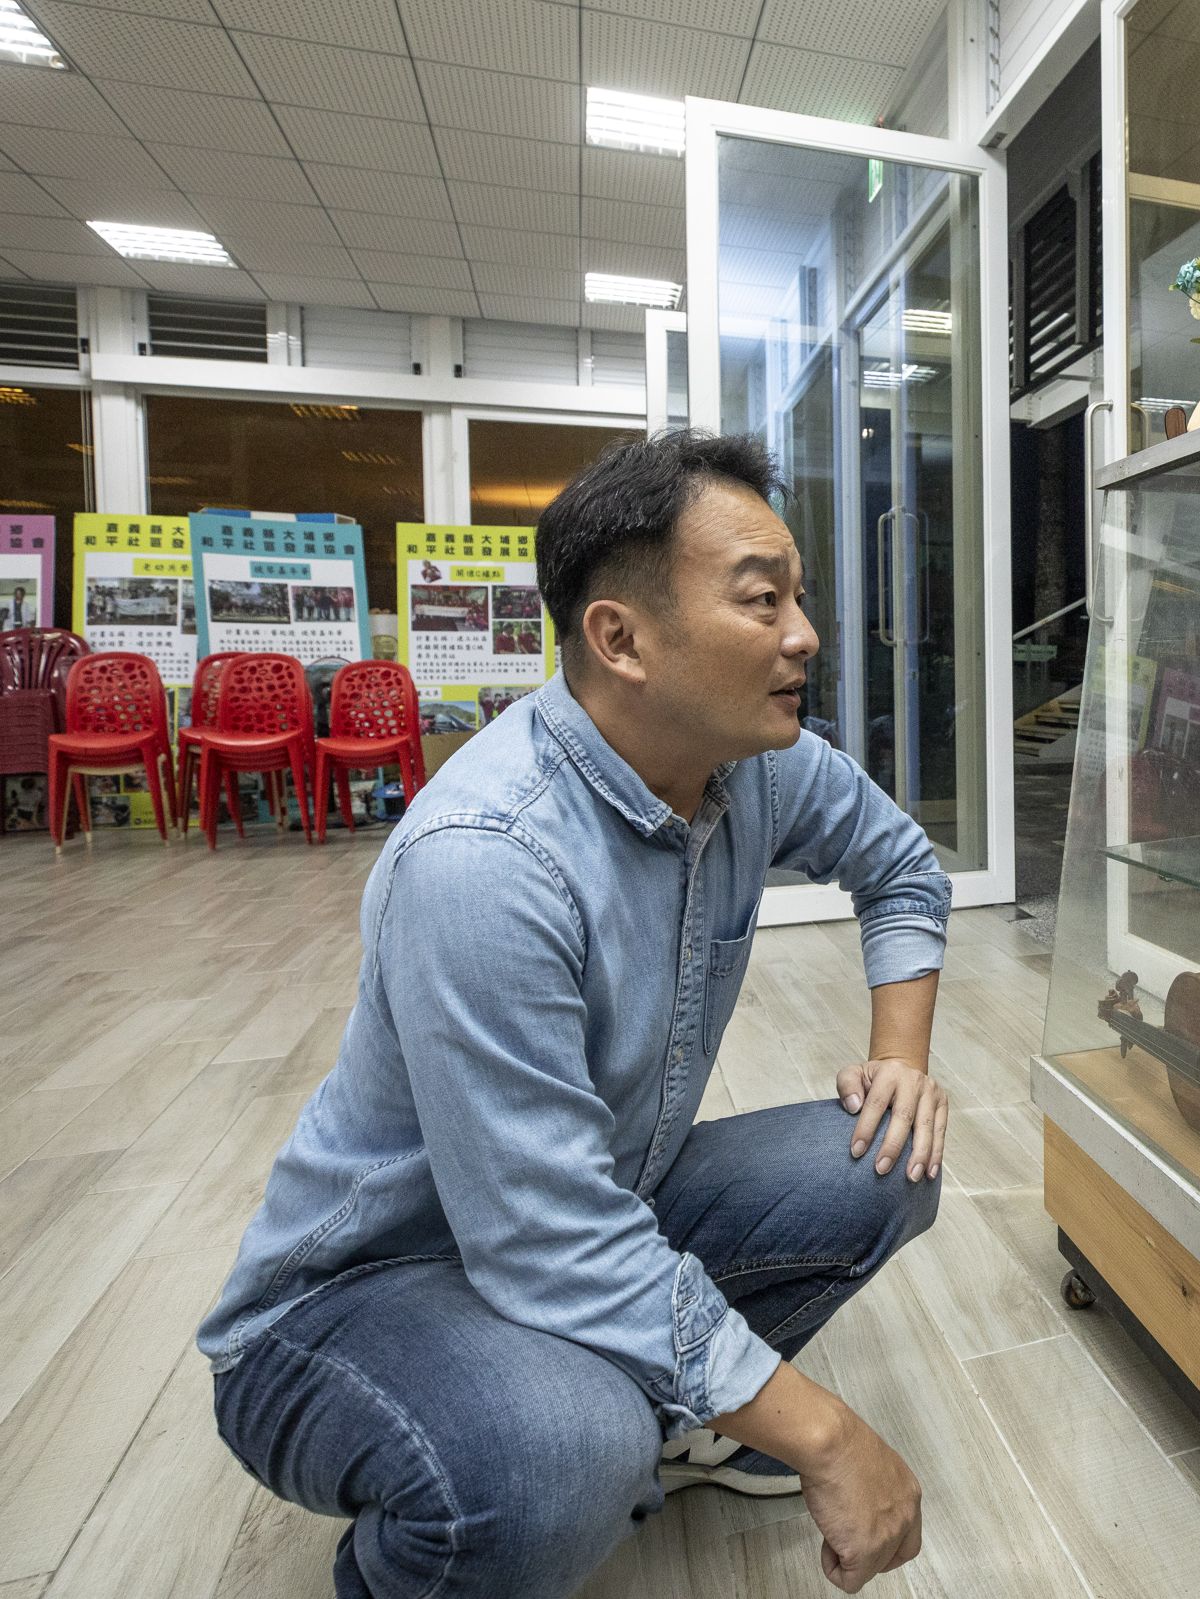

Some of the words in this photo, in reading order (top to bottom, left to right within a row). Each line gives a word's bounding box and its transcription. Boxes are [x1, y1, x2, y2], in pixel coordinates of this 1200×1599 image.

[221, 525, 335, 542] 嘉義縣大埔鄉
[426, 533, 528, 545] 嘉義縣大埔鄉
[84, 536, 184, 549] 和平社區發
[202, 536, 355, 555] 和平社區發展協會
[407, 544, 528, 557] 和平社區發展協
